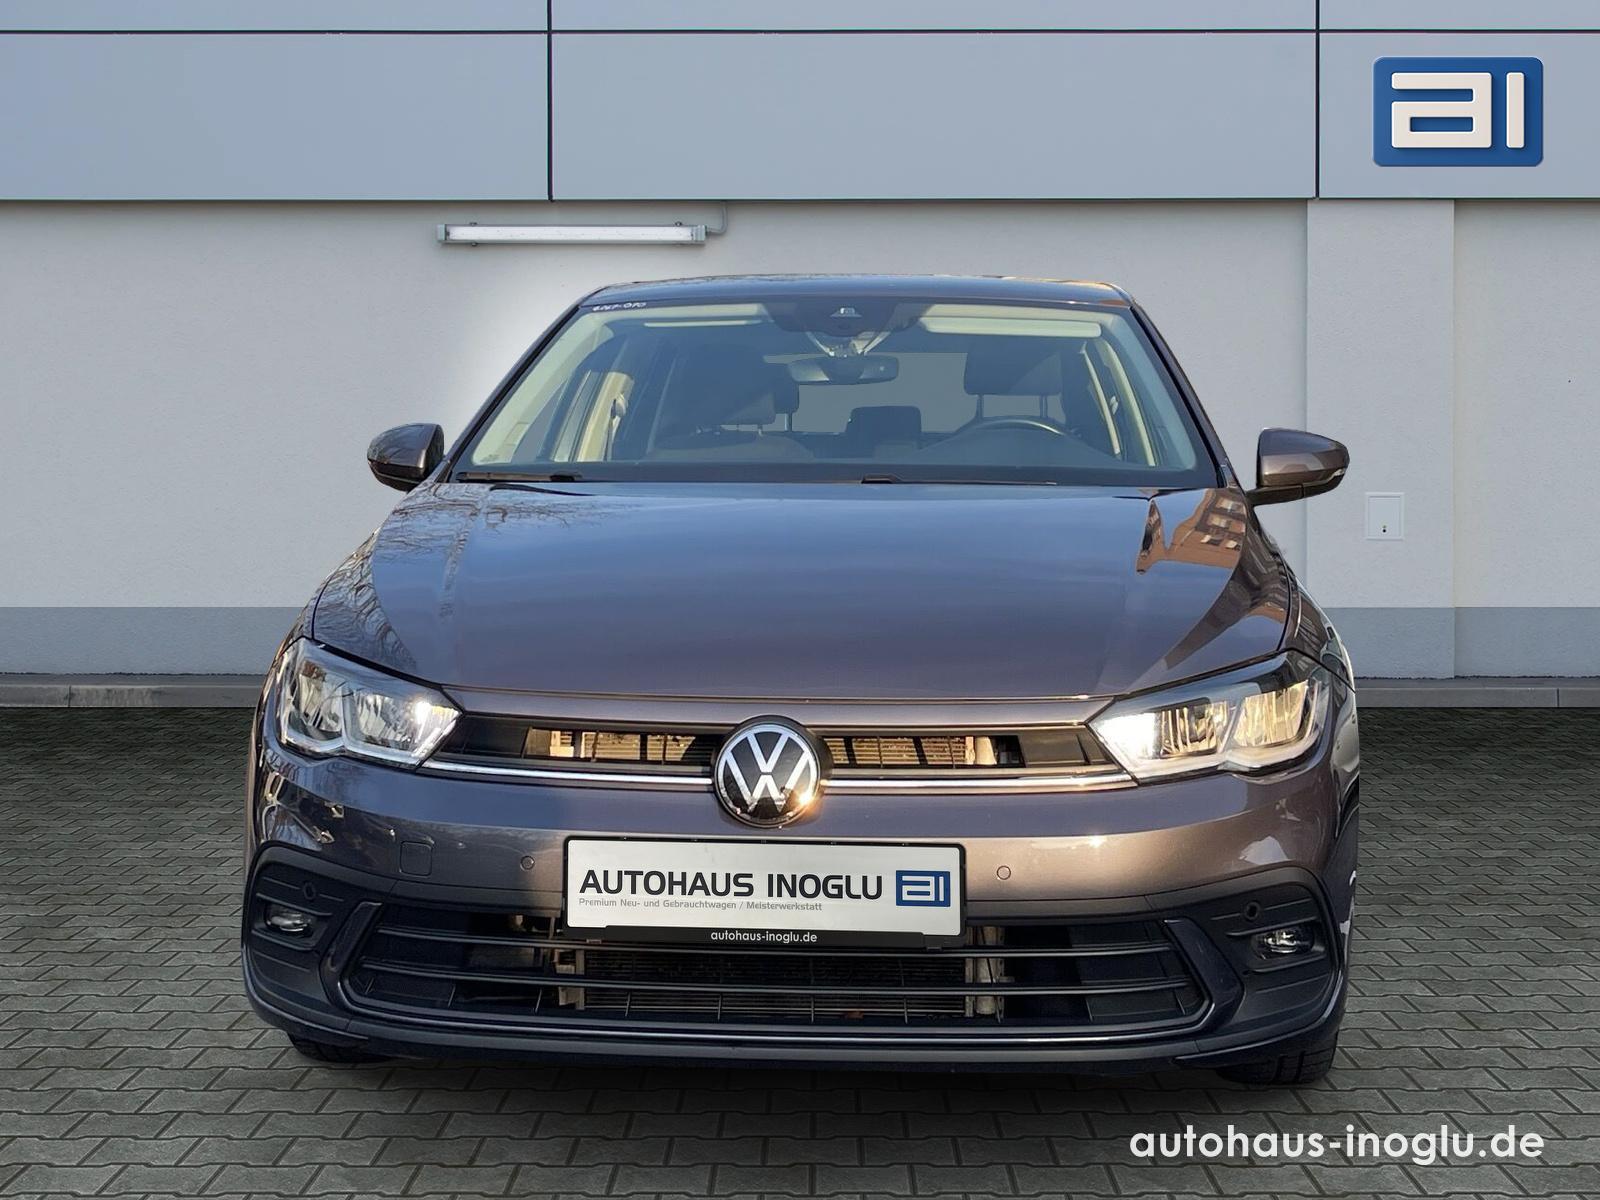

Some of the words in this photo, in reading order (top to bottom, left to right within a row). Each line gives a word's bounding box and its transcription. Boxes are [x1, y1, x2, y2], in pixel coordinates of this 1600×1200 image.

[579, 869, 755, 897] AUTOHAUS
[767, 873, 883, 900] INOGLU
[579, 898, 617, 907] Premium
[620, 899, 640, 907] Neu-
[643, 900, 660, 908] und
[663, 900, 737, 911] Gebrauchtwagen
[746, 901, 823, 912] Meisterwerkstatt
[710, 930, 818, 945] autohaus-inoglu.de
